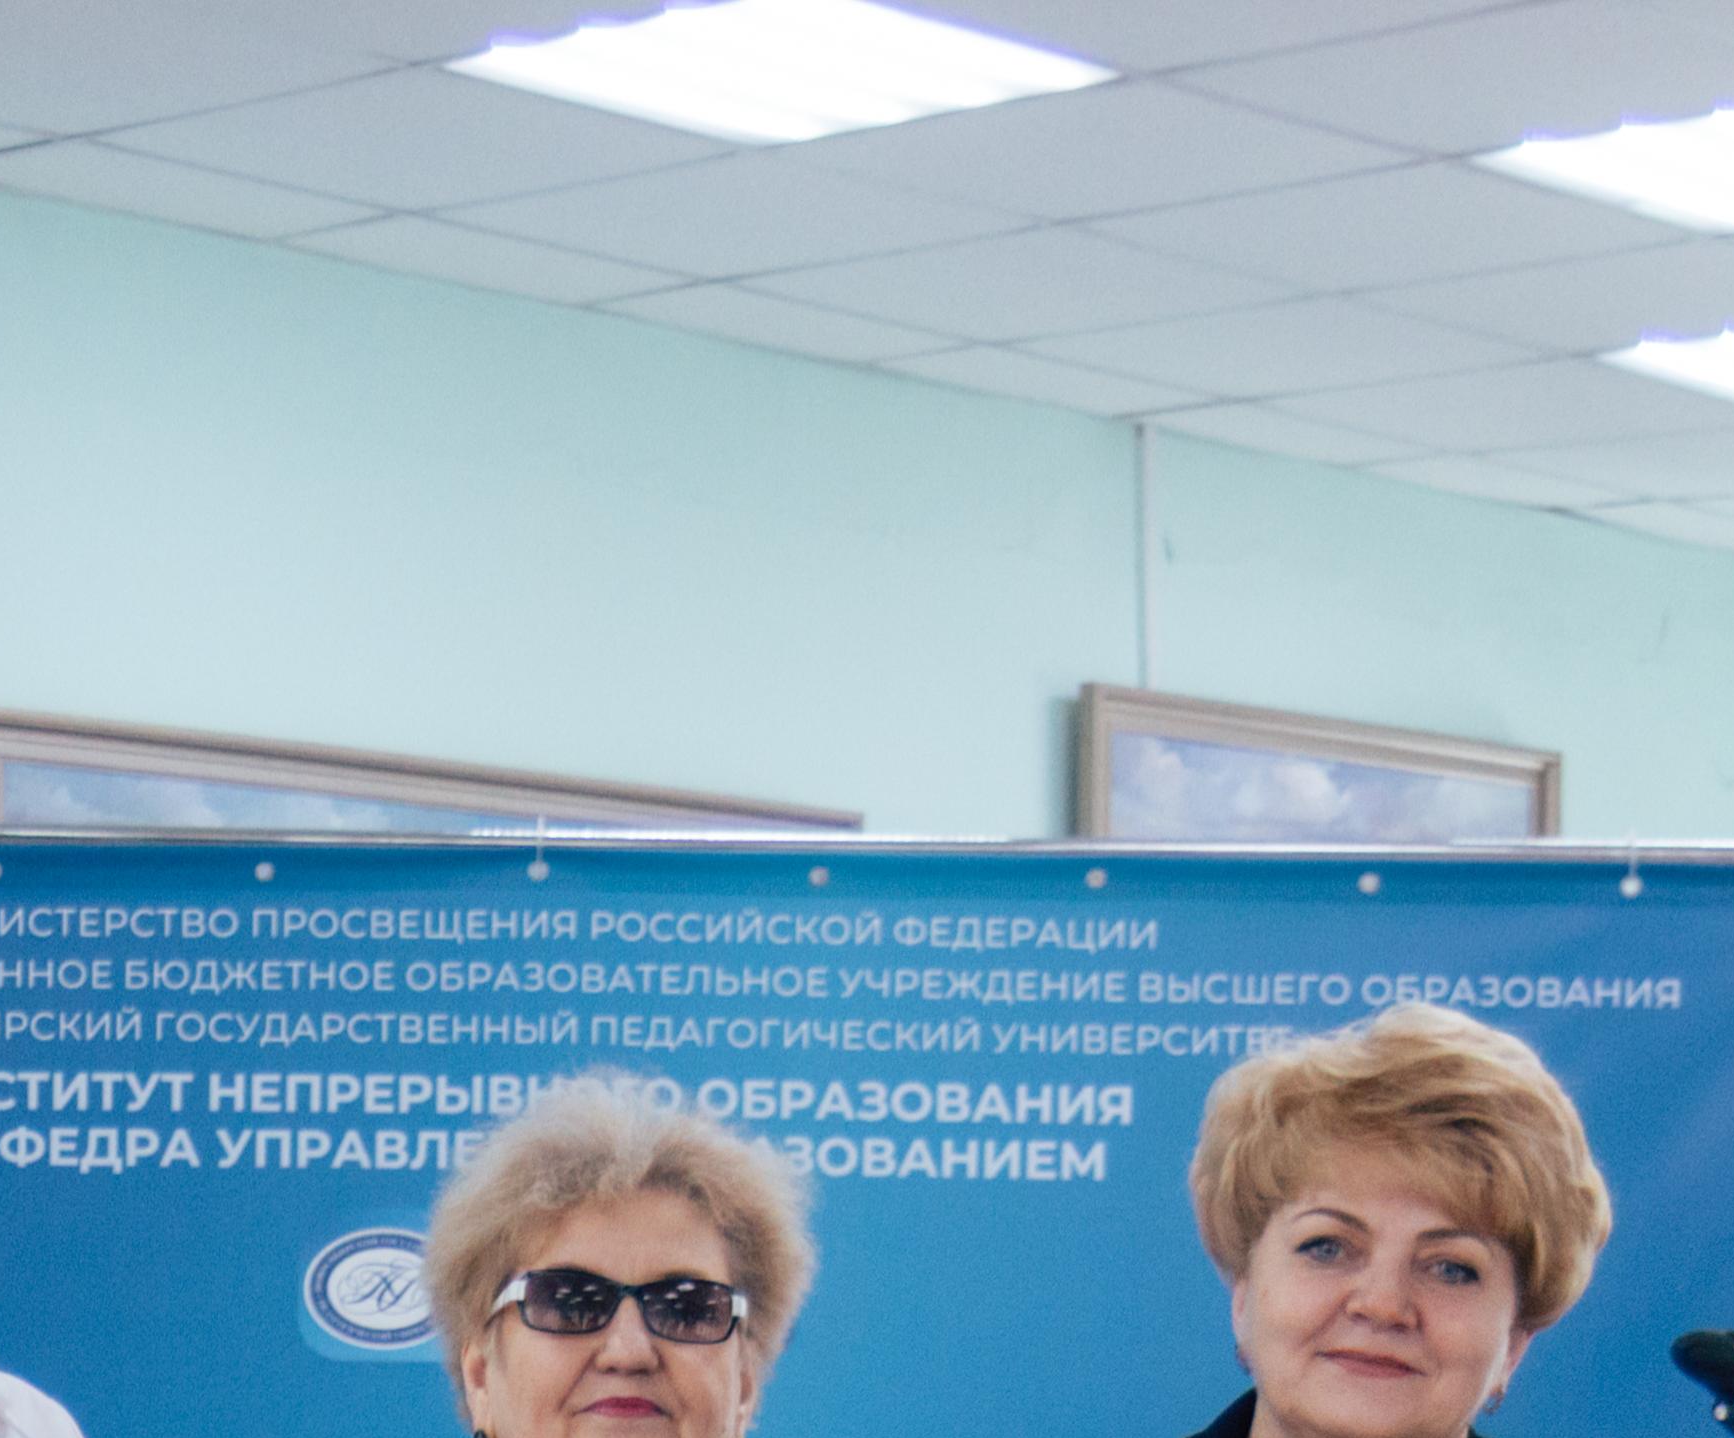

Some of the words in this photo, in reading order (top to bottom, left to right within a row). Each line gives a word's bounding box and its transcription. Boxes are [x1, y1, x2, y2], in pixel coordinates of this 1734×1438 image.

[251, 907, 579, 945] ПРОСВЕЩЕНИЯ
[589, 907, 882, 947] РОССИЙСКОЙ
[892, 915, 1160, 955] ФЕДЕРАЦИИ
[124, 959, 396, 996] БЮДЖЕТНОЕ
[405, 960, 828, 999] ОБРАЗОВАТЕЛЬНОЕ
[838, 967, 1126, 1006] УЧРЕЖДЕНИЕ
[1138, 971, 1354, 1006] ВЫСШЕГО
[1360, 973, 1683, 1010] ОБРАЗОВАНИЯ
[155, 1007, 580, 1048] ГОСУДАРСТВЕННЫЙ
[589, 1013, 981, 1053] ПЕДАГОГИЧЕСКИЙ
[696, 1077, 1134, 1126] ОБРАЗОВАНИЯ
